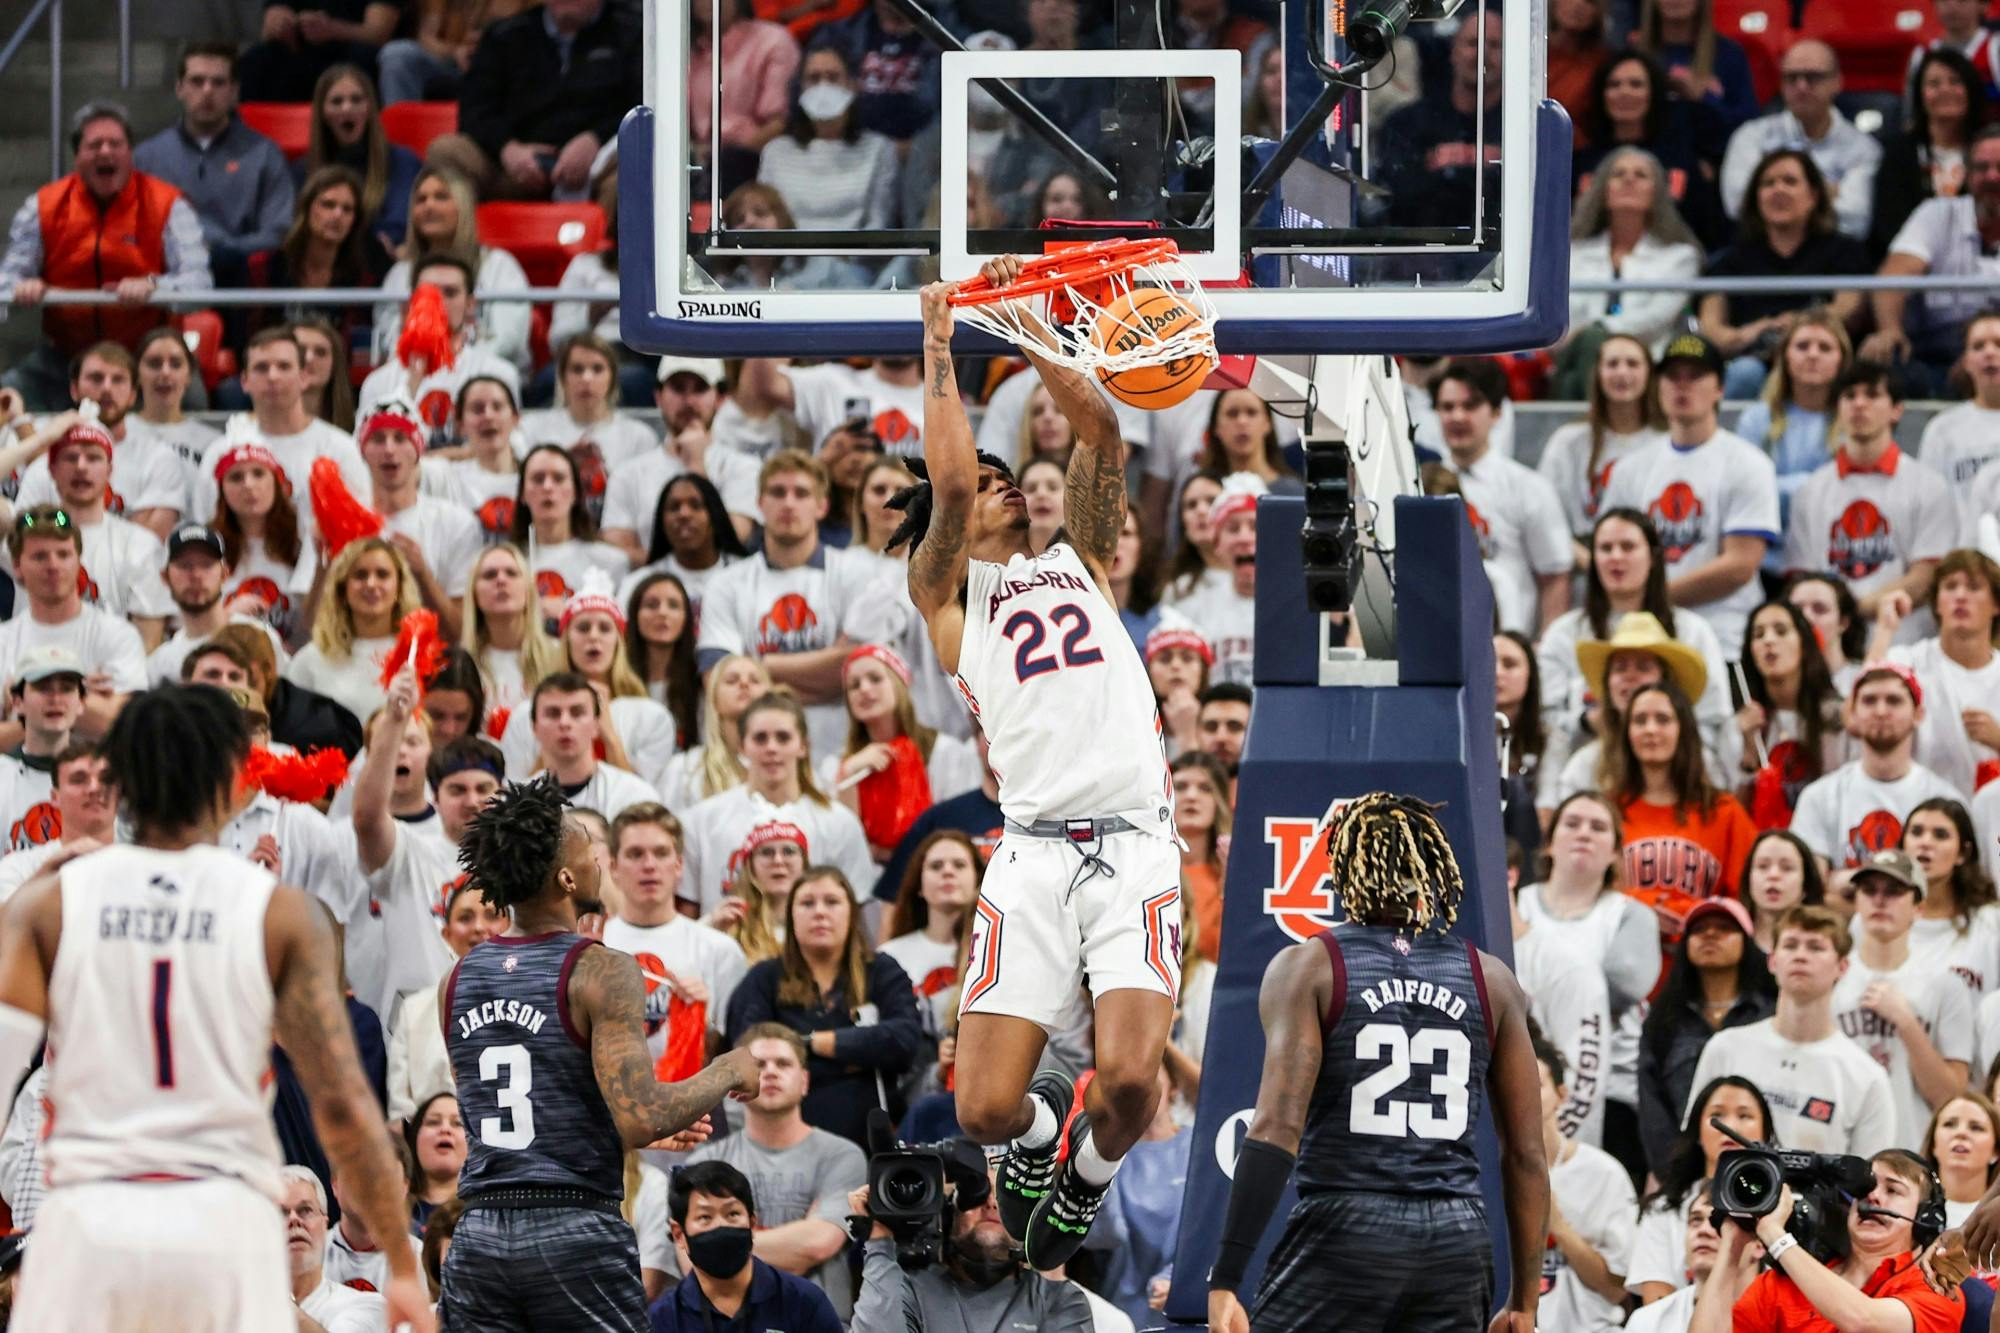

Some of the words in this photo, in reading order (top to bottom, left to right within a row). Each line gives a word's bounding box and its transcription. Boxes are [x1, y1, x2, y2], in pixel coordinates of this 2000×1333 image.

[678, 300, 761, 319] SPALDING
[1115, 304, 1188, 352] Wilson
[1001, 603, 1105, 685] 22
[153, 957, 175, 1089] 1
[458, 999, 547, 1040] JACKSON
[1360, 978, 1468, 1021] RADFORD
[478, 1044, 536, 1150] 3
[1349, 1023, 1472, 1141] 23
[1558, 1014, 1600, 1138] TIGERS
